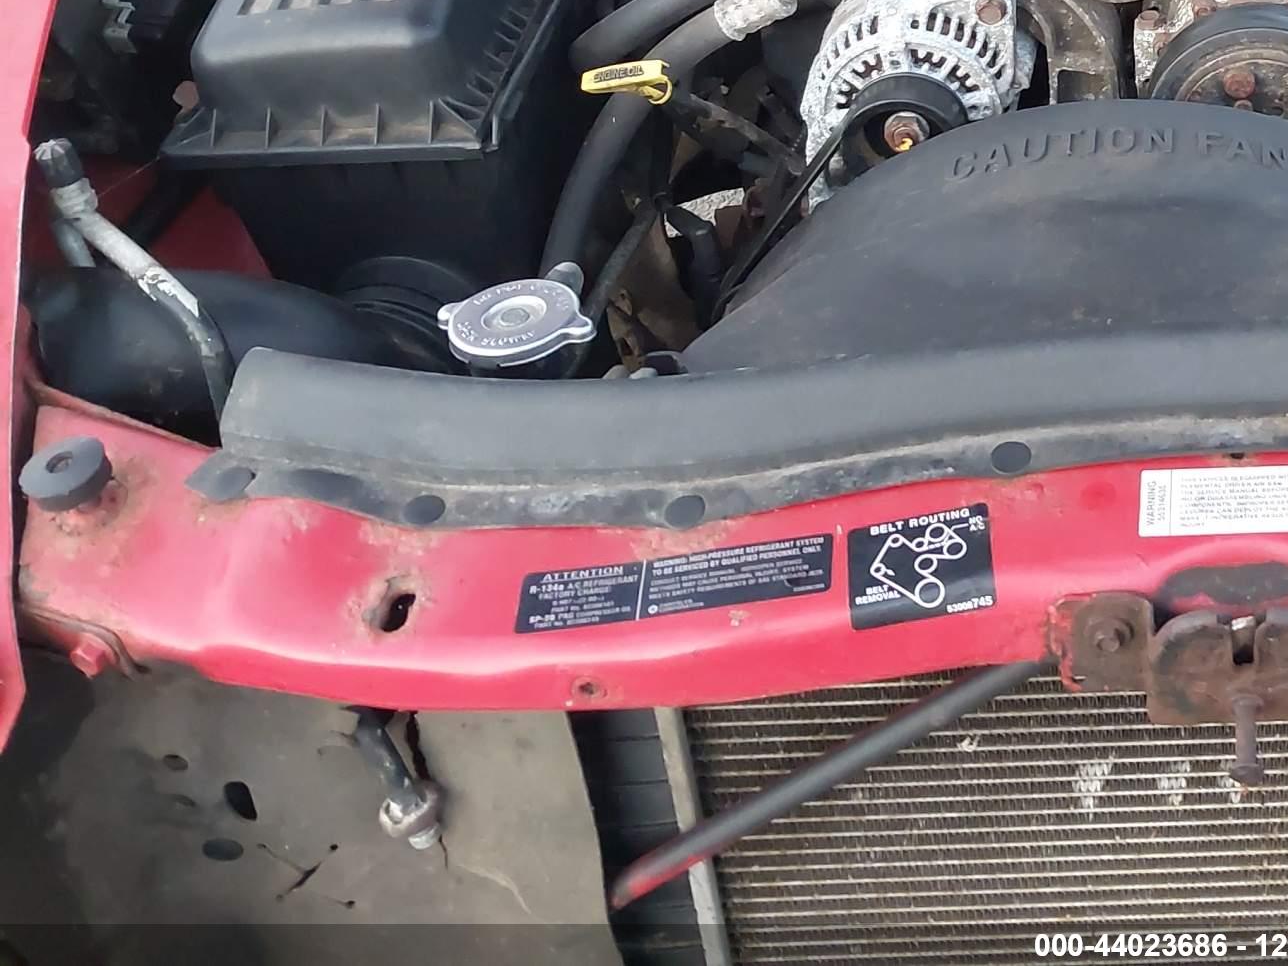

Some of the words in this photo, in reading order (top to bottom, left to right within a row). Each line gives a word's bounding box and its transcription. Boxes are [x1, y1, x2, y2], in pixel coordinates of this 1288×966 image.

[593, 66, 627, 83] ENGINE
[629, 64, 645, 76] OIL
[951, 127, 1176, 181] CAUTION
[1146, 481, 1157, 526] WARNING
[870, 521, 904, 535] BELT
[909, 508, 970, 528] ROUTING
[968, 516, 982, 524] NO
[542, 566, 624, 582] ATTENTION
[529, 584, 564, 594] R-134a
[538, 590, 575, 600] FACTORY
[866, 585, 889, 595] BELT
[855, 590, 900, 605] REMOVAL
